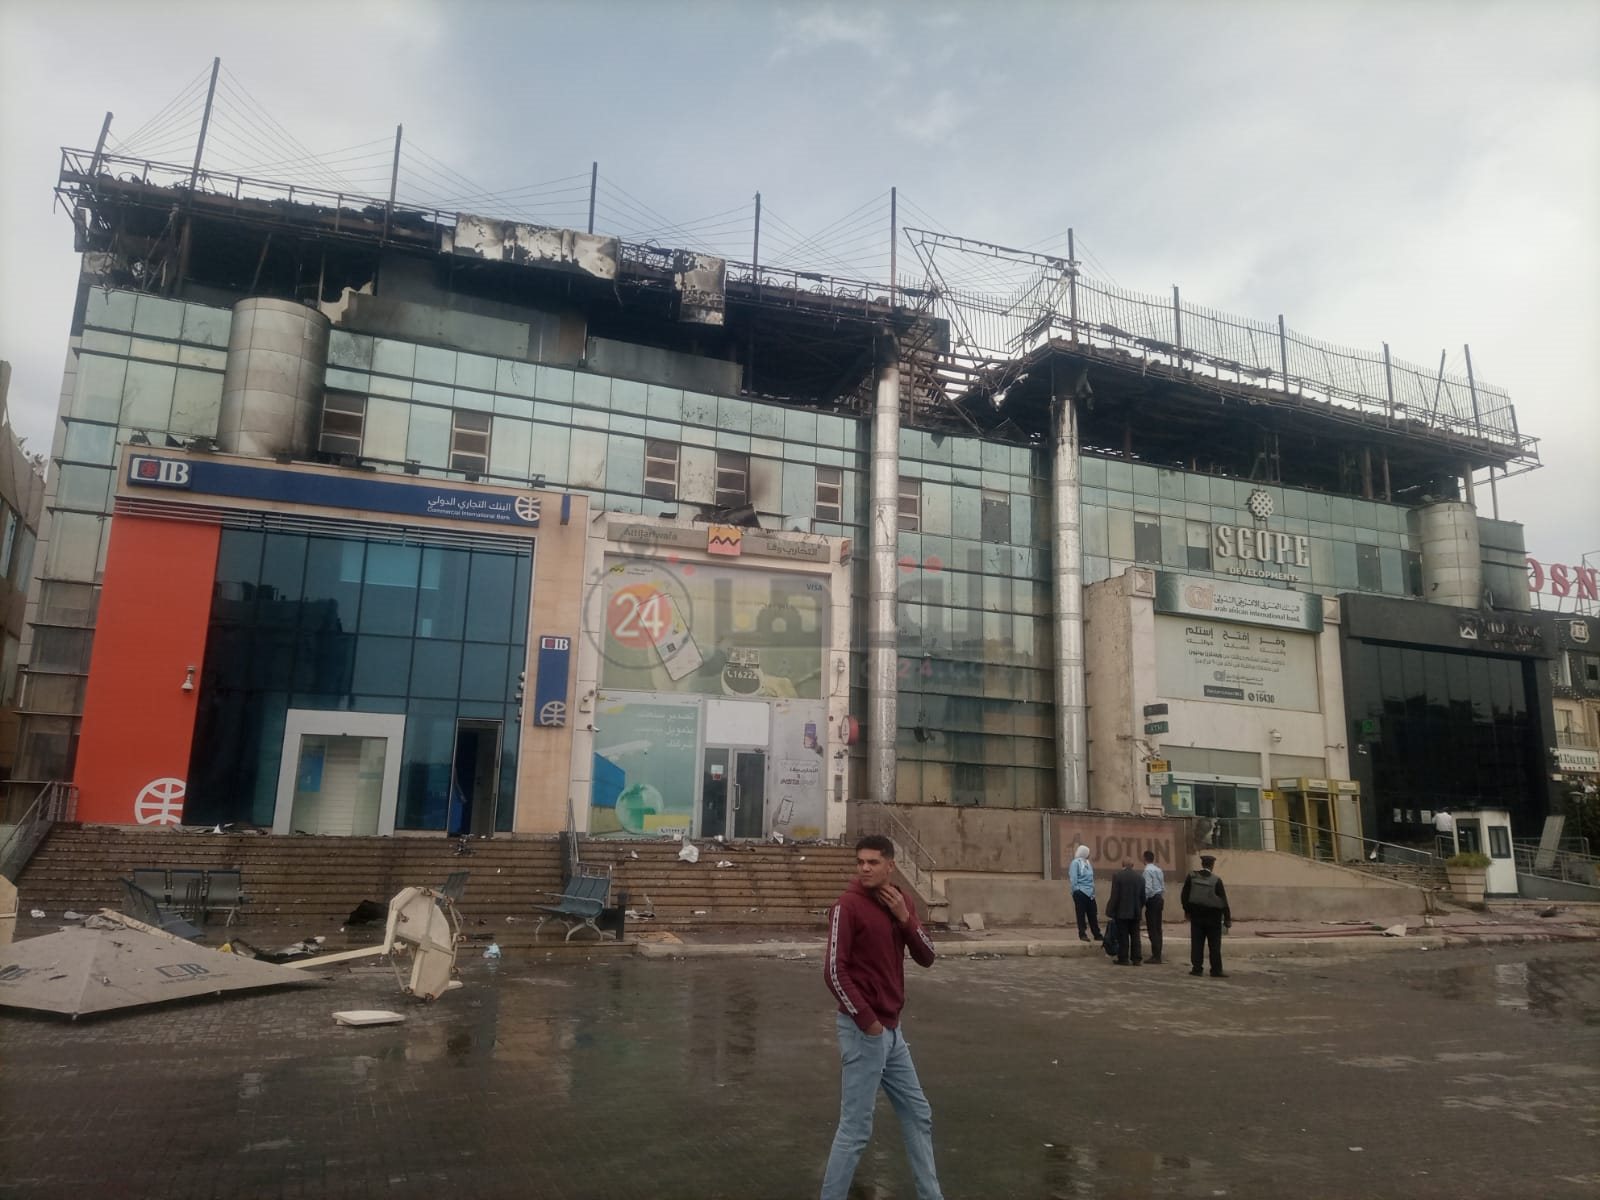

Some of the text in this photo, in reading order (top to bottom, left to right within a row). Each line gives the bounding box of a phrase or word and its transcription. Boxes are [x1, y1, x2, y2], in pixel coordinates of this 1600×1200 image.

[130, 457, 189, 485] CIB
[427, 496, 456, 507] الدولي
[488, 503, 511, 511] البنك
[427, 507, 461, 516] Commercial
[461, 510, 496, 519] International
[1216, 524, 1310, 568] SCOPE
[806, 583, 823, 591] VISA
[1215, 605, 1300, 622] arab african international bank
[541, 637, 569, 651] CIB
[1090, 835, 1171, 865] JOTUN
